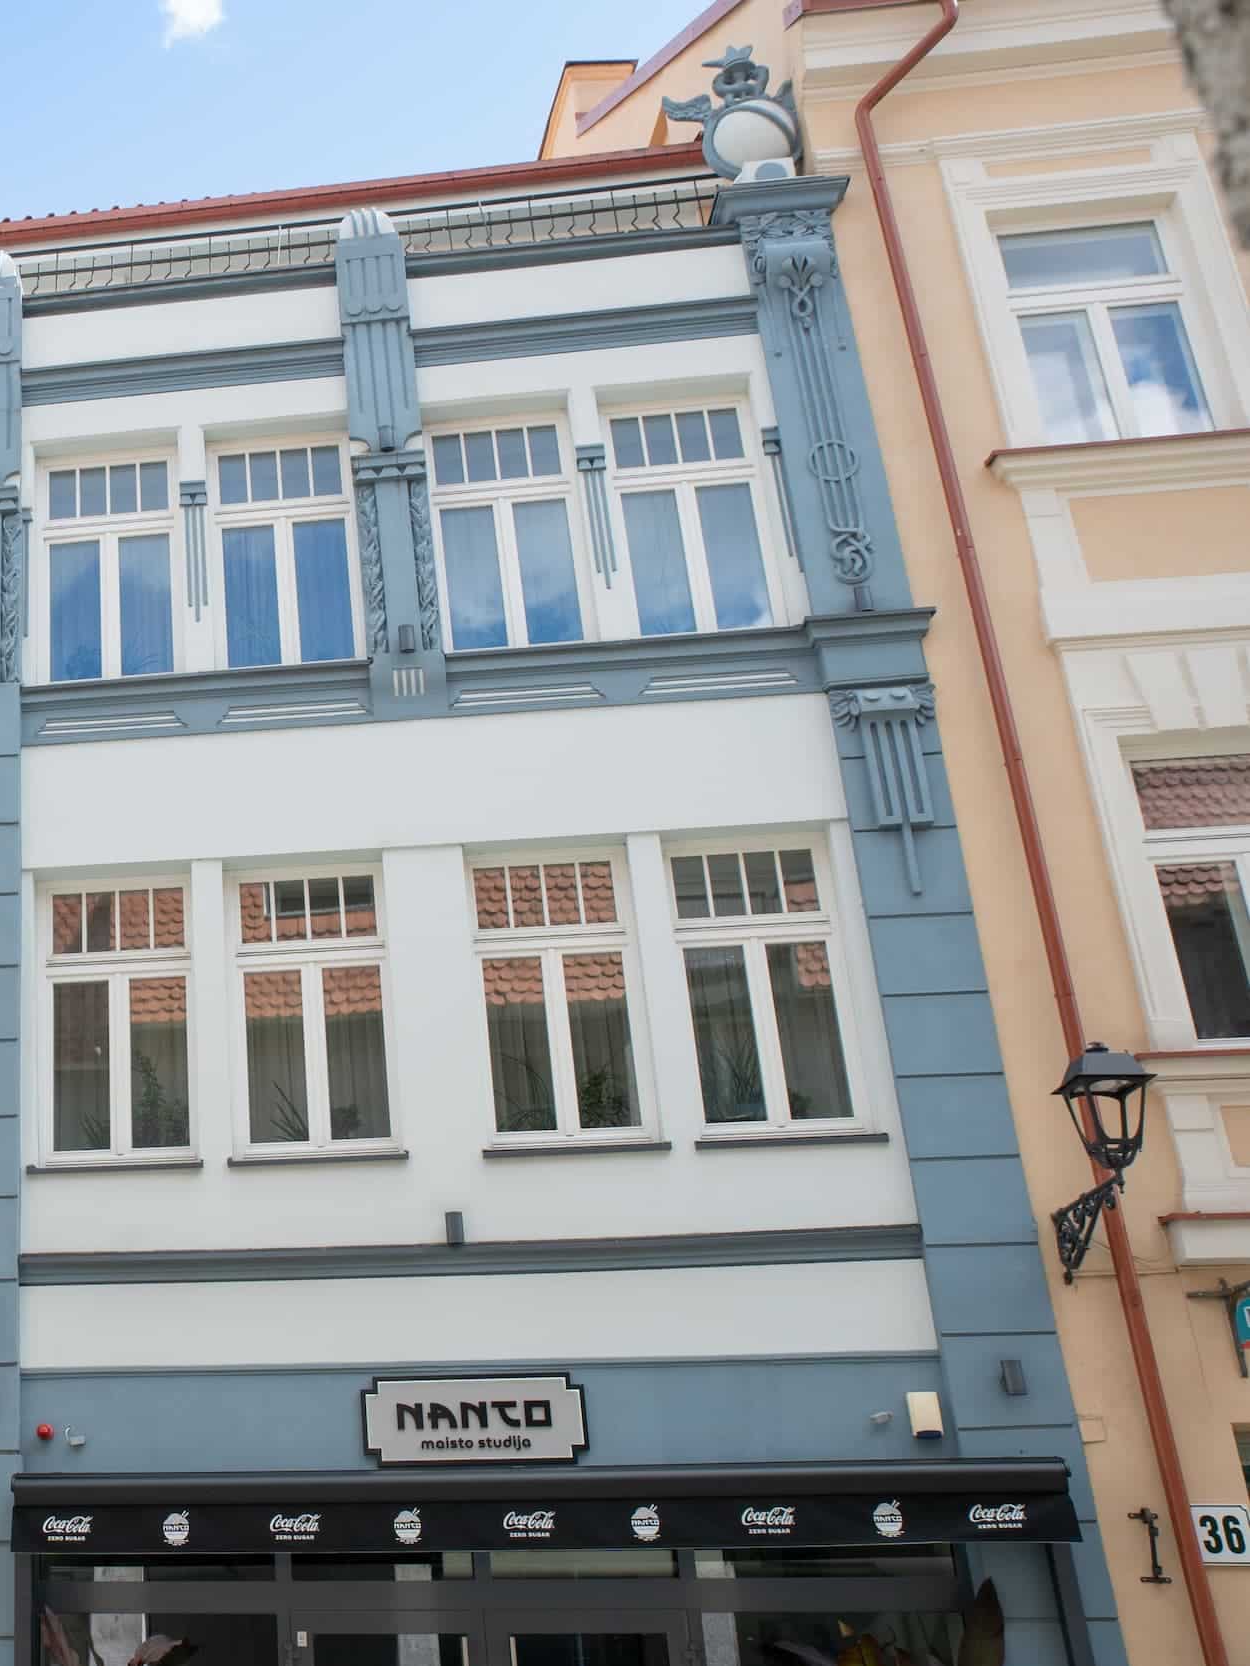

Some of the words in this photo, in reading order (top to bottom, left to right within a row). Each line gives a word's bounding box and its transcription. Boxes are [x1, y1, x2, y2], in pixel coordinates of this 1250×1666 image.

[396, 1400, 553, 1431] NANTO
[421, 1436, 474, 1451] maisto
[478, 1435, 532, 1452] studija
[503, 1511, 556, 1530] Coca-Cola
[741, 1506, 797, 1527] Coca-Cola
[969, 1503, 1028, 1523] Coca-Cola
[42, 1515, 94, 1534] Coca-Cola
[269, 1514, 322, 1533] Coca-Cola
[1199, 1514, 1247, 1554] 36
